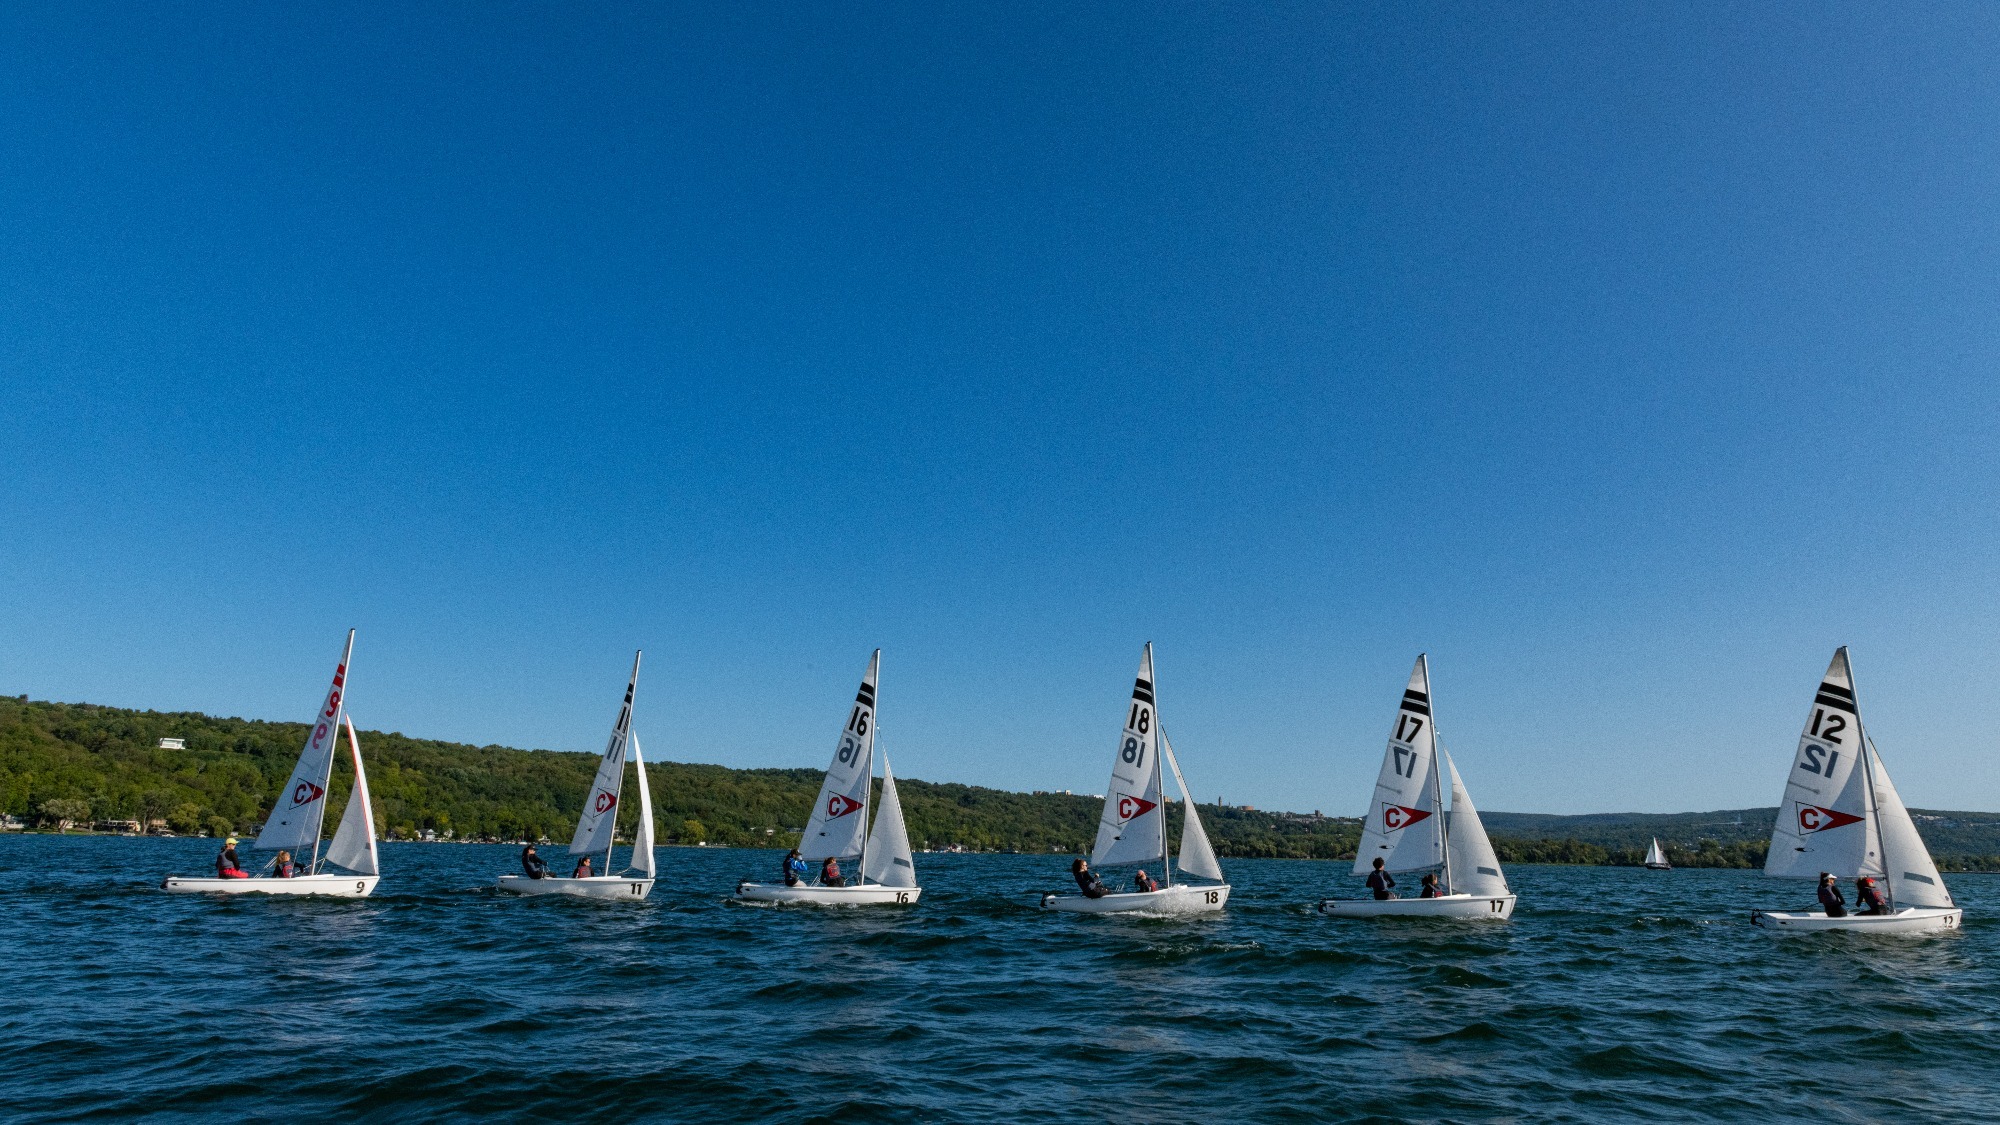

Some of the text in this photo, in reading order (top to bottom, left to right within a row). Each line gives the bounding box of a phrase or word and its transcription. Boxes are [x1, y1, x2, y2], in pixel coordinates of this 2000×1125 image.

[326, 691, 340, 717] 9
[849, 706, 870, 737] 16
[1128, 703, 1150, 735] 18
[1396, 714, 1423, 744] 17
[1810, 708, 1846, 745] 12
[293, 783, 307, 804] C
[594, 793, 606, 814] C
[827, 796, 841, 817] C
[1119, 798, 1132, 819] C
[1385, 807, 1401, 828] C
[1800, 808, 1820, 830] C
[355, 881, 366, 894] 9
[630, 883, 643, 896] 11
[895, 891, 909, 904] 16
[1204, 891, 1219, 904] 18
[1490, 900, 1505, 913] 17
